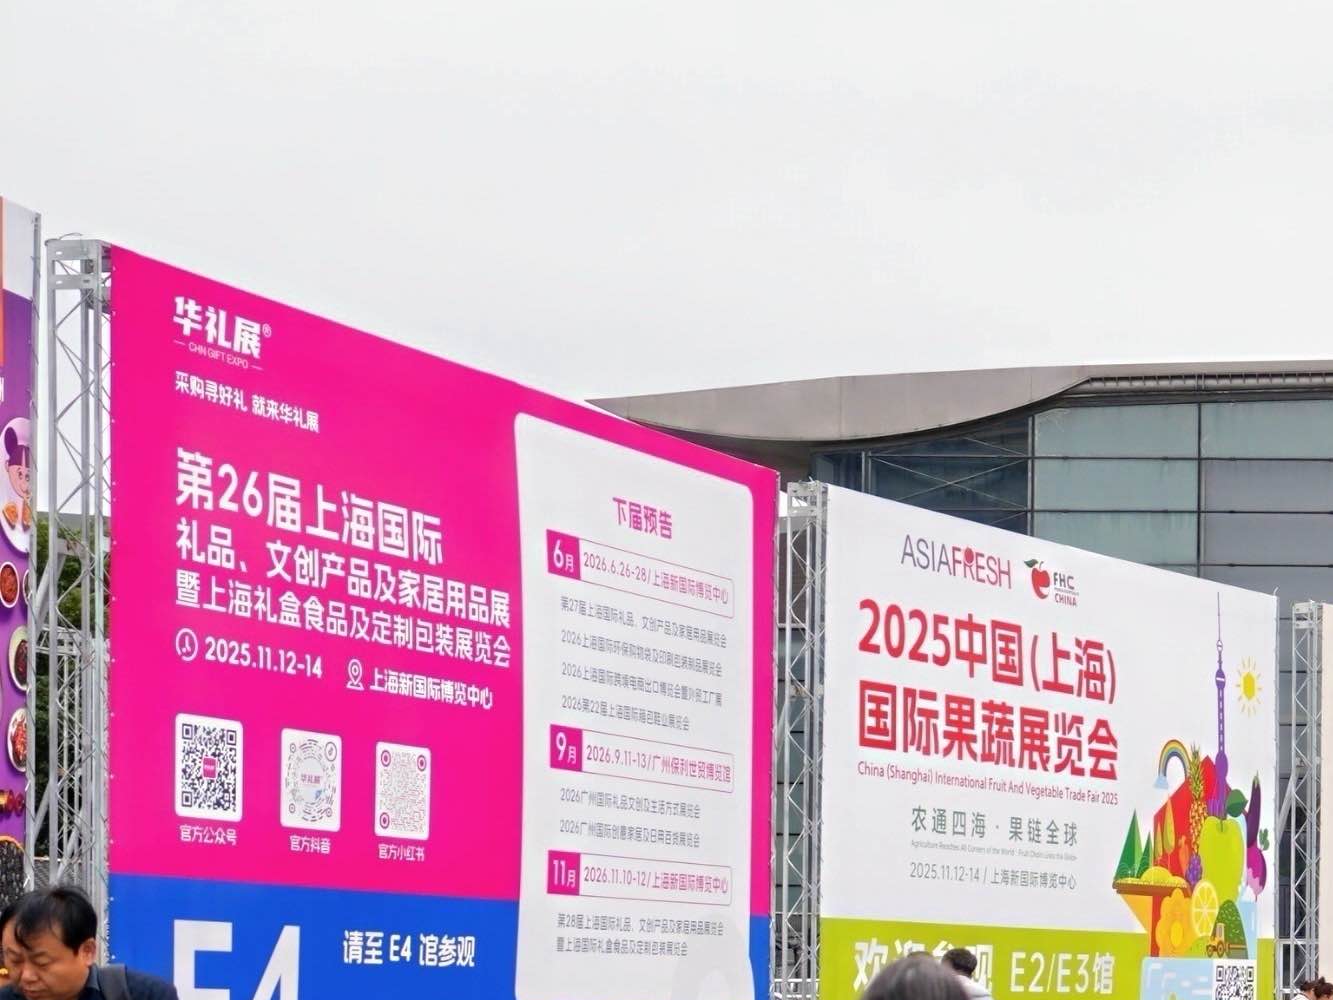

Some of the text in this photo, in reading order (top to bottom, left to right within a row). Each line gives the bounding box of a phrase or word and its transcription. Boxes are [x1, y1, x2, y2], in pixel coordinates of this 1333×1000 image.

[207, 346, 226, 363] GIFT
[226, 353, 249, 369] EXPO
[175, 371, 320, 433] 采购寻好礼 就来华礼展
[176, 447, 443, 566] 第26届上海国际
[612, 496, 673, 539] 下届预告
[176, 516, 511, 630] 礼品、文创产品及家居用品展
[553, 539, 575, 573] 6月
[901, 534, 1012, 589] ASIAFRESH
[1053, 571, 1075, 591] FHC
[1054, 592, 1078, 608] CHINA
[176, 568, 511, 668] 暨上海礼盒食品及定制包装展览会
[205, 636, 323, 679] 2025.11.12-14
[858, 598, 1116, 705] 2025中国(上海)
[370, 668, 493, 709] 上海新国际博览中心
[556, 732, 577, 765] 9月
[859, 679, 1118, 781] 国际果蔬展览会
[857, 760, 1118, 806] China (Shanghai) International Fruit And Vegetable Trade Fair 2025
[179, 824, 237, 846] 官方公众号
[289, 834, 331, 855] 官方抖音
[911, 805, 1079, 847] 农通四海 果链全球
[378, 843, 425, 863] 官方小红书
[553, 859, 576, 888] 11月
[910, 861, 1076, 890] 2025.11.12-14 上海新国际博览中心
[343, 930, 477, 968] 请至 E4 馆参观
[1010, 951, 1115, 995] E2/E3馆
